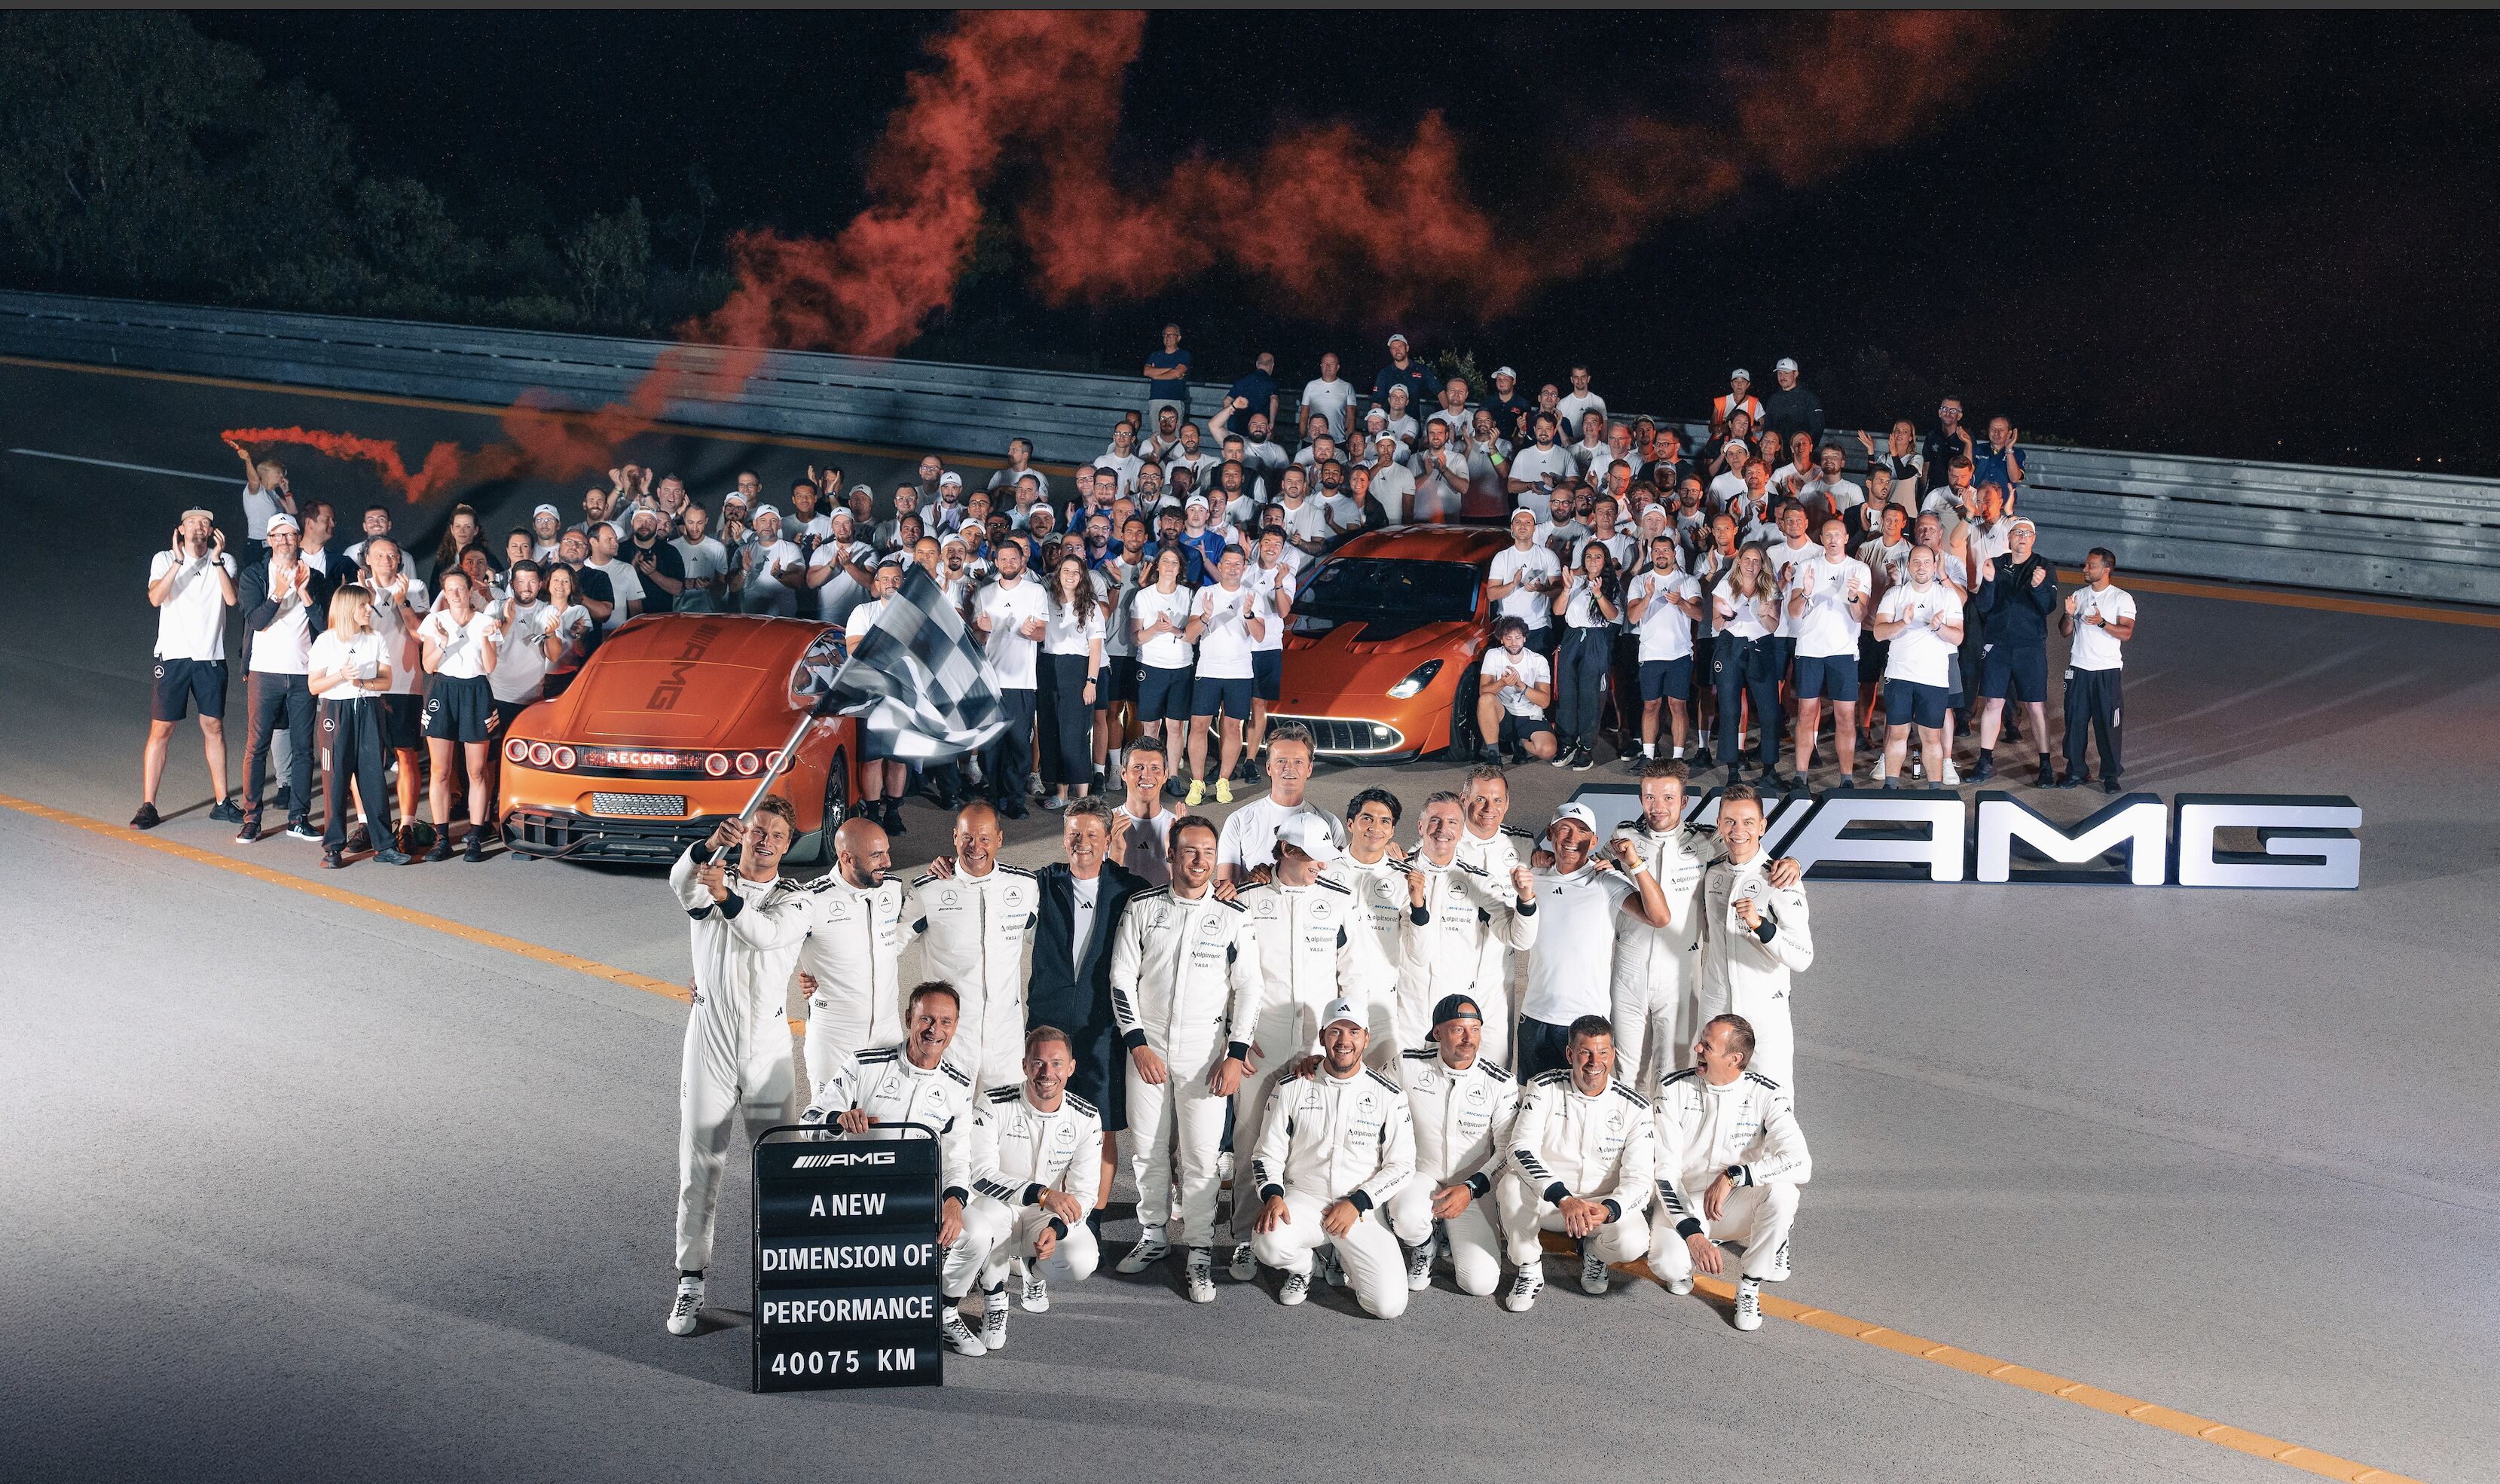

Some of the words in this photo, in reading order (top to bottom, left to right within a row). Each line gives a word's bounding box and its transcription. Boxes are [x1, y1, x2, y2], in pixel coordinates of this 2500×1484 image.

[646, 642, 708, 710] AMG
[607, 752, 677, 765] RECORD
[1796, 794, 2362, 888] AMG
[1676, 874, 1701, 883] alpitronic
[1372, 914, 1398, 923] alpitronic
[1197, 951, 1221, 960] alpitronic
[814, 1000, 828, 1009] OMP
[924, 1112, 947, 1122] MICHELIN
[1353, 1130, 1377, 1138] alpitronic
[828, 1151, 896, 1167] AMG
[809, 1195, 827, 1217] A
[833, 1192, 886, 1216] NEW
[763, 1244, 896, 1272] DIMENSION
[903, 1243, 933, 1266] OF
[763, 1296, 934, 1324] PERFORMANCE
[771, 1350, 860, 1376] 40075
[877, 1348, 915, 1371] KM
